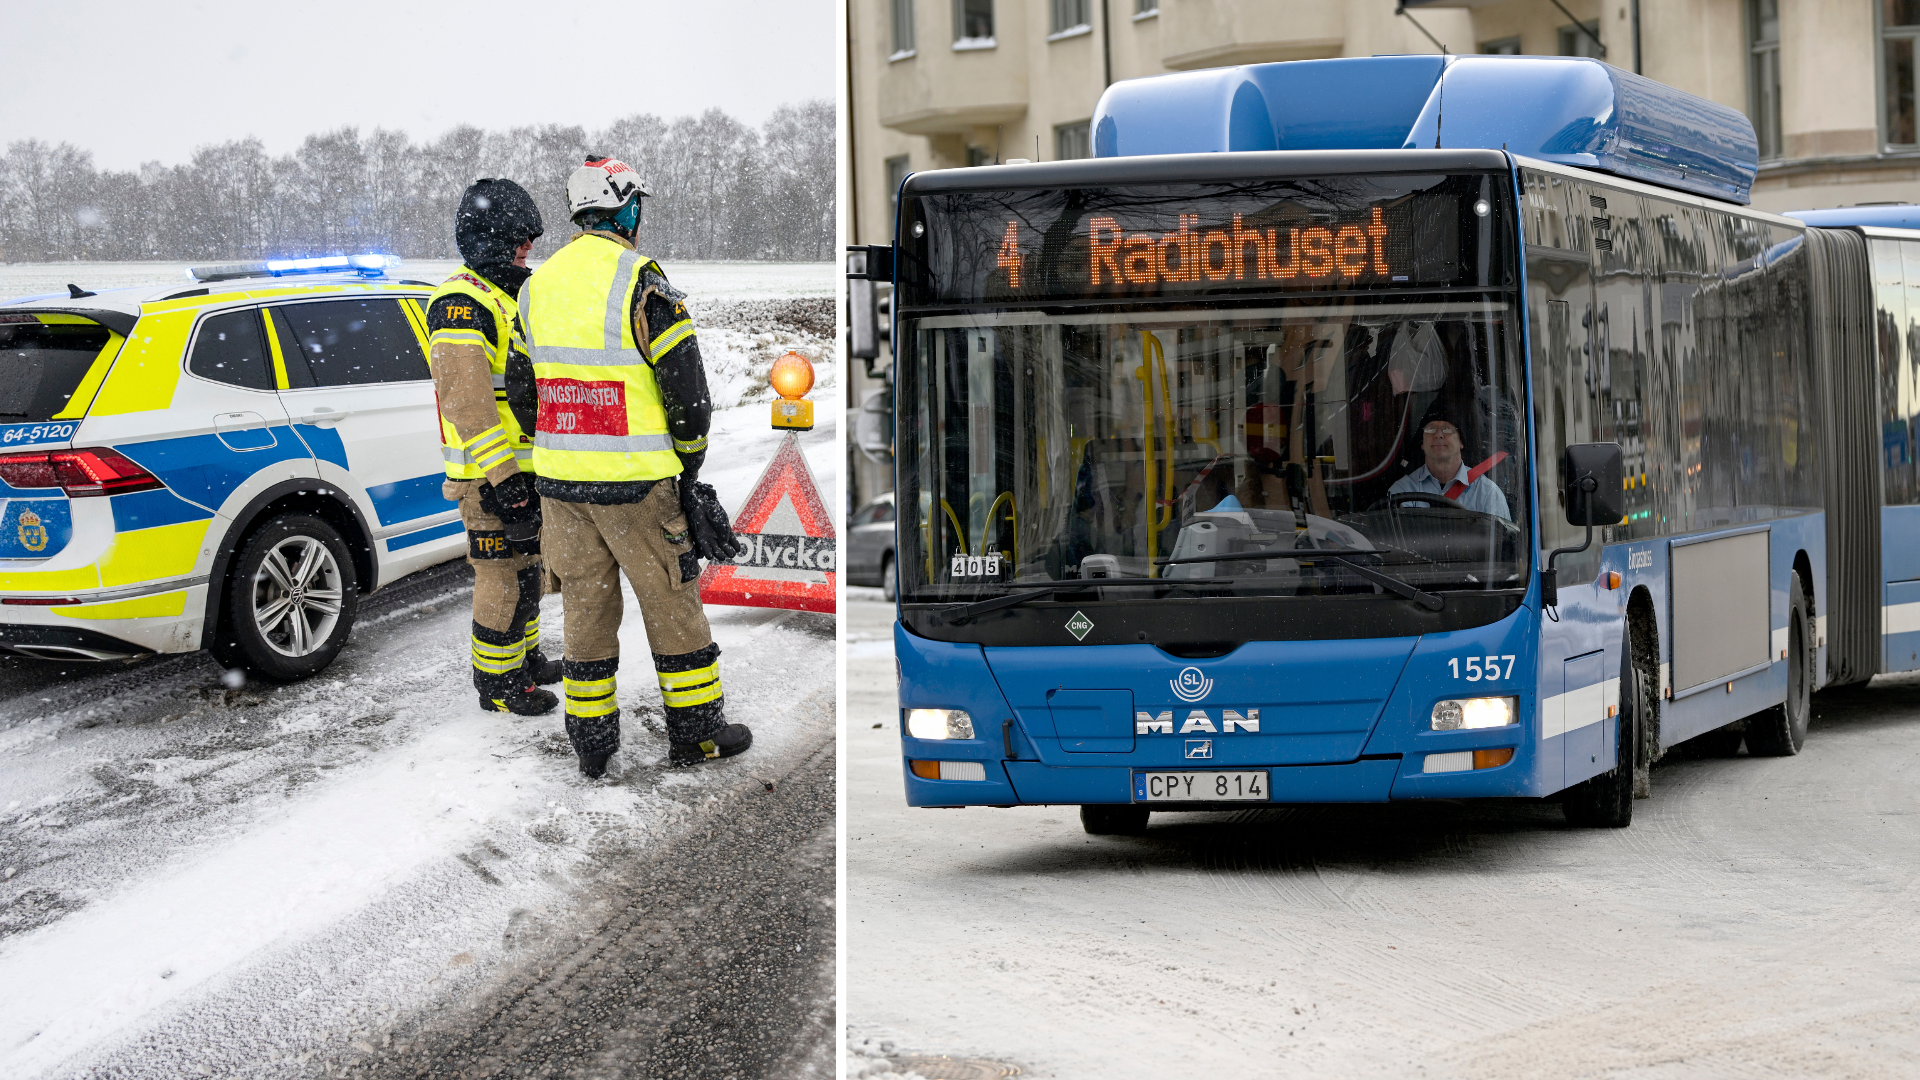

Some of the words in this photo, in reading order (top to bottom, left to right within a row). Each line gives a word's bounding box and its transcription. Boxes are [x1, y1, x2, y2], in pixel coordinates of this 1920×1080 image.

[997, 221, 1021, 288] 4
[1090, 206, 1389, 285] Radiohuset
[446, 306, 472, 320] TPE
[556, 412, 576, 430] SYD
[3, 424, 73, 443] 64-5120
[477, 537, 504, 552] TPE
[733, 535, 836, 569] Olycka
[1071, 621, 1088, 630] CNG
[1448, 655, 1516, 682] 1557
[1184, 674, 1200, 685] SL
[1136, 709, 1260, 735] MAN
[1150, 775, 1195, 797] CPY
[1215, 775, 1262, 797] 814
